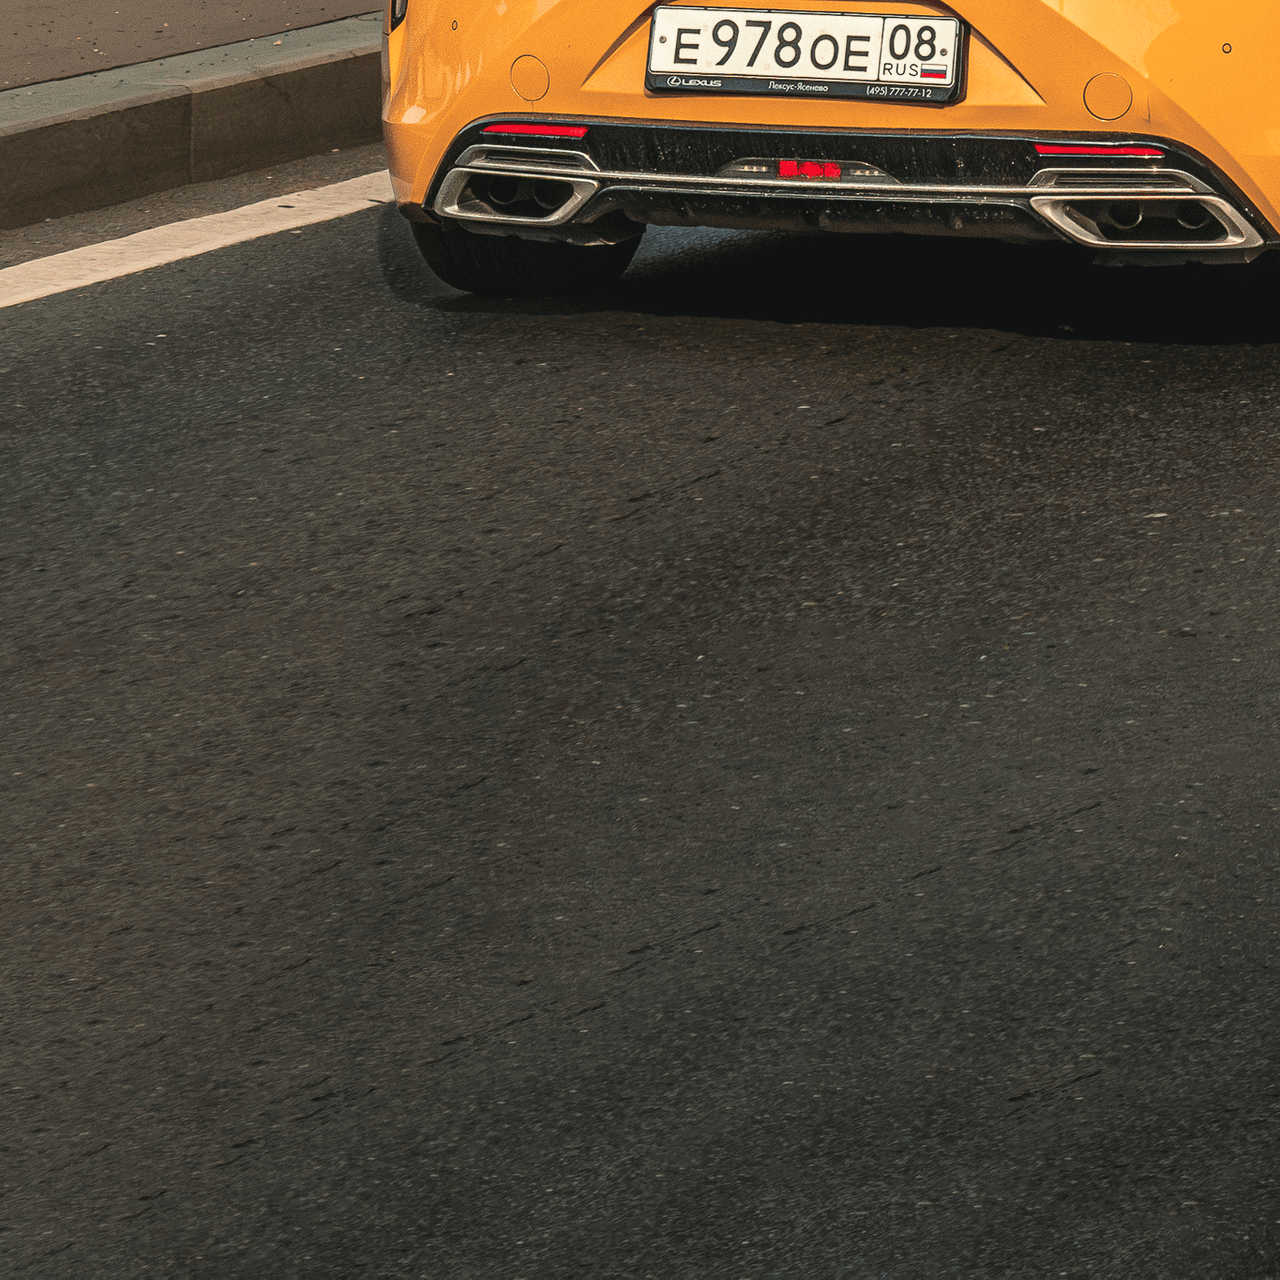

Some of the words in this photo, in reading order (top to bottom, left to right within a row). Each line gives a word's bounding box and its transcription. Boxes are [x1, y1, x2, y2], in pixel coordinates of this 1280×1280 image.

[673, 19, 871, 72] Е978ОЕ
[889, 24, 937, 61] 08
[883, 62, 919, 77] RUS
[682, 78, 722, 87] LEXUS
[768, 81, 829, 92] Лексус-Ясенево
[866, 85, 888, 96] (495)
[889, 86, 932, 98] 777-77-12
